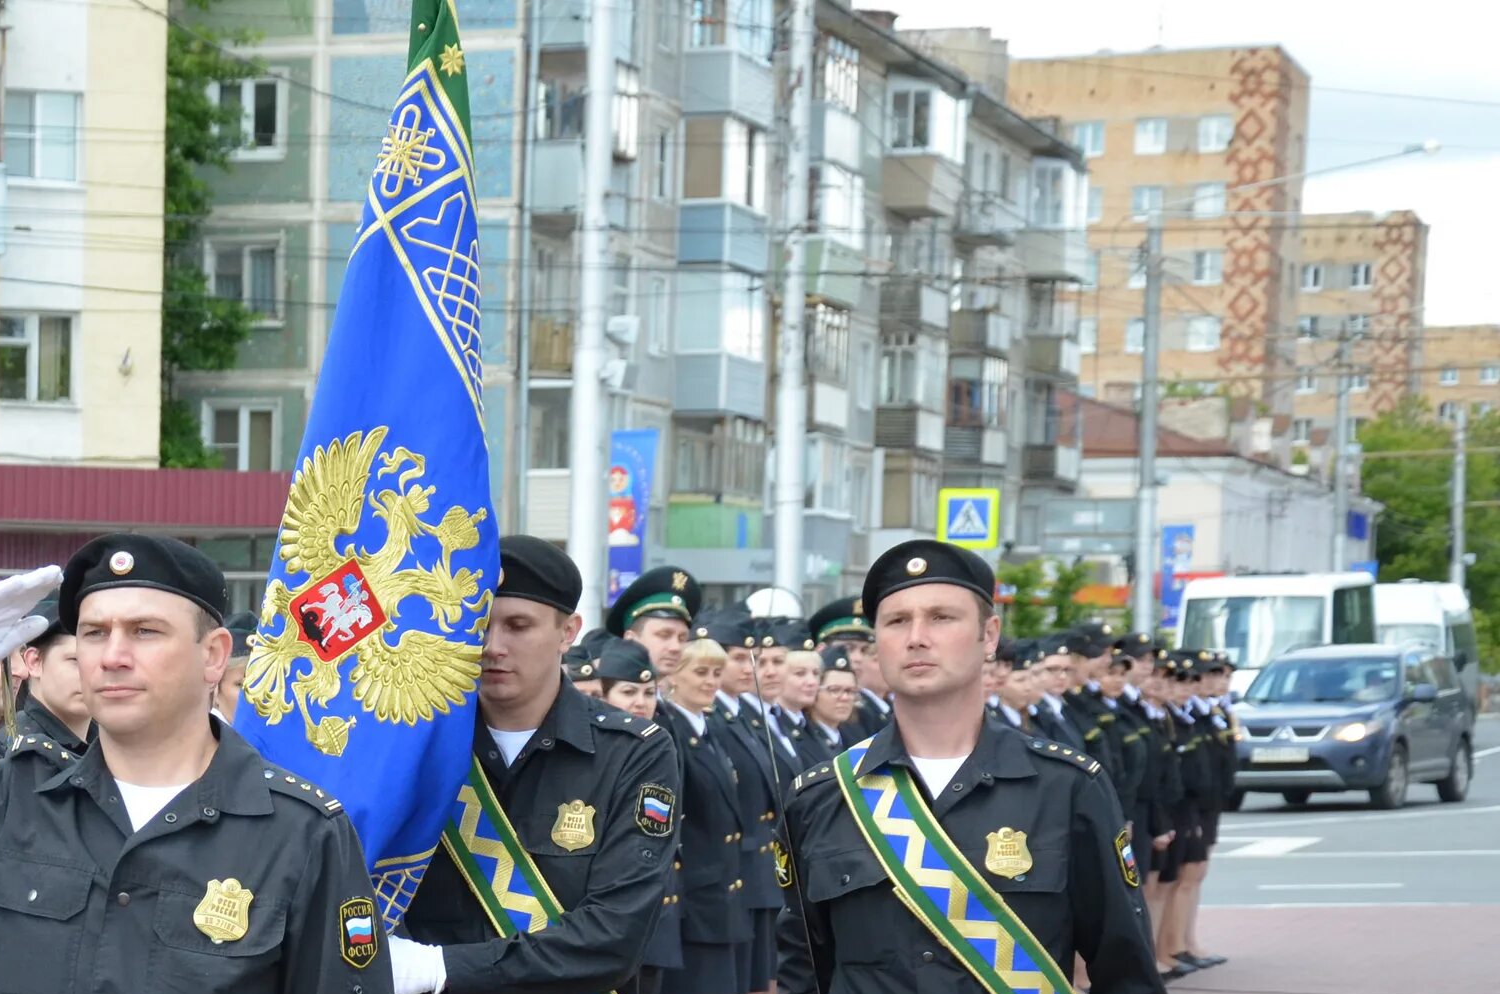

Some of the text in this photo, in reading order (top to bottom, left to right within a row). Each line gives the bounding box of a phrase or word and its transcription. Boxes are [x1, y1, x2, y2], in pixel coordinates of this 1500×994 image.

[645, 788, 672, 802] РОССИЯ
[641, 817, 667, 831] ФССП
[210, 903, 238, 918] РОССИИ
[217, 897, 237, 910] ФССП
[343, 904, 372, 919] РОССИЯ
[348, 943, 374, 958] ФССП
